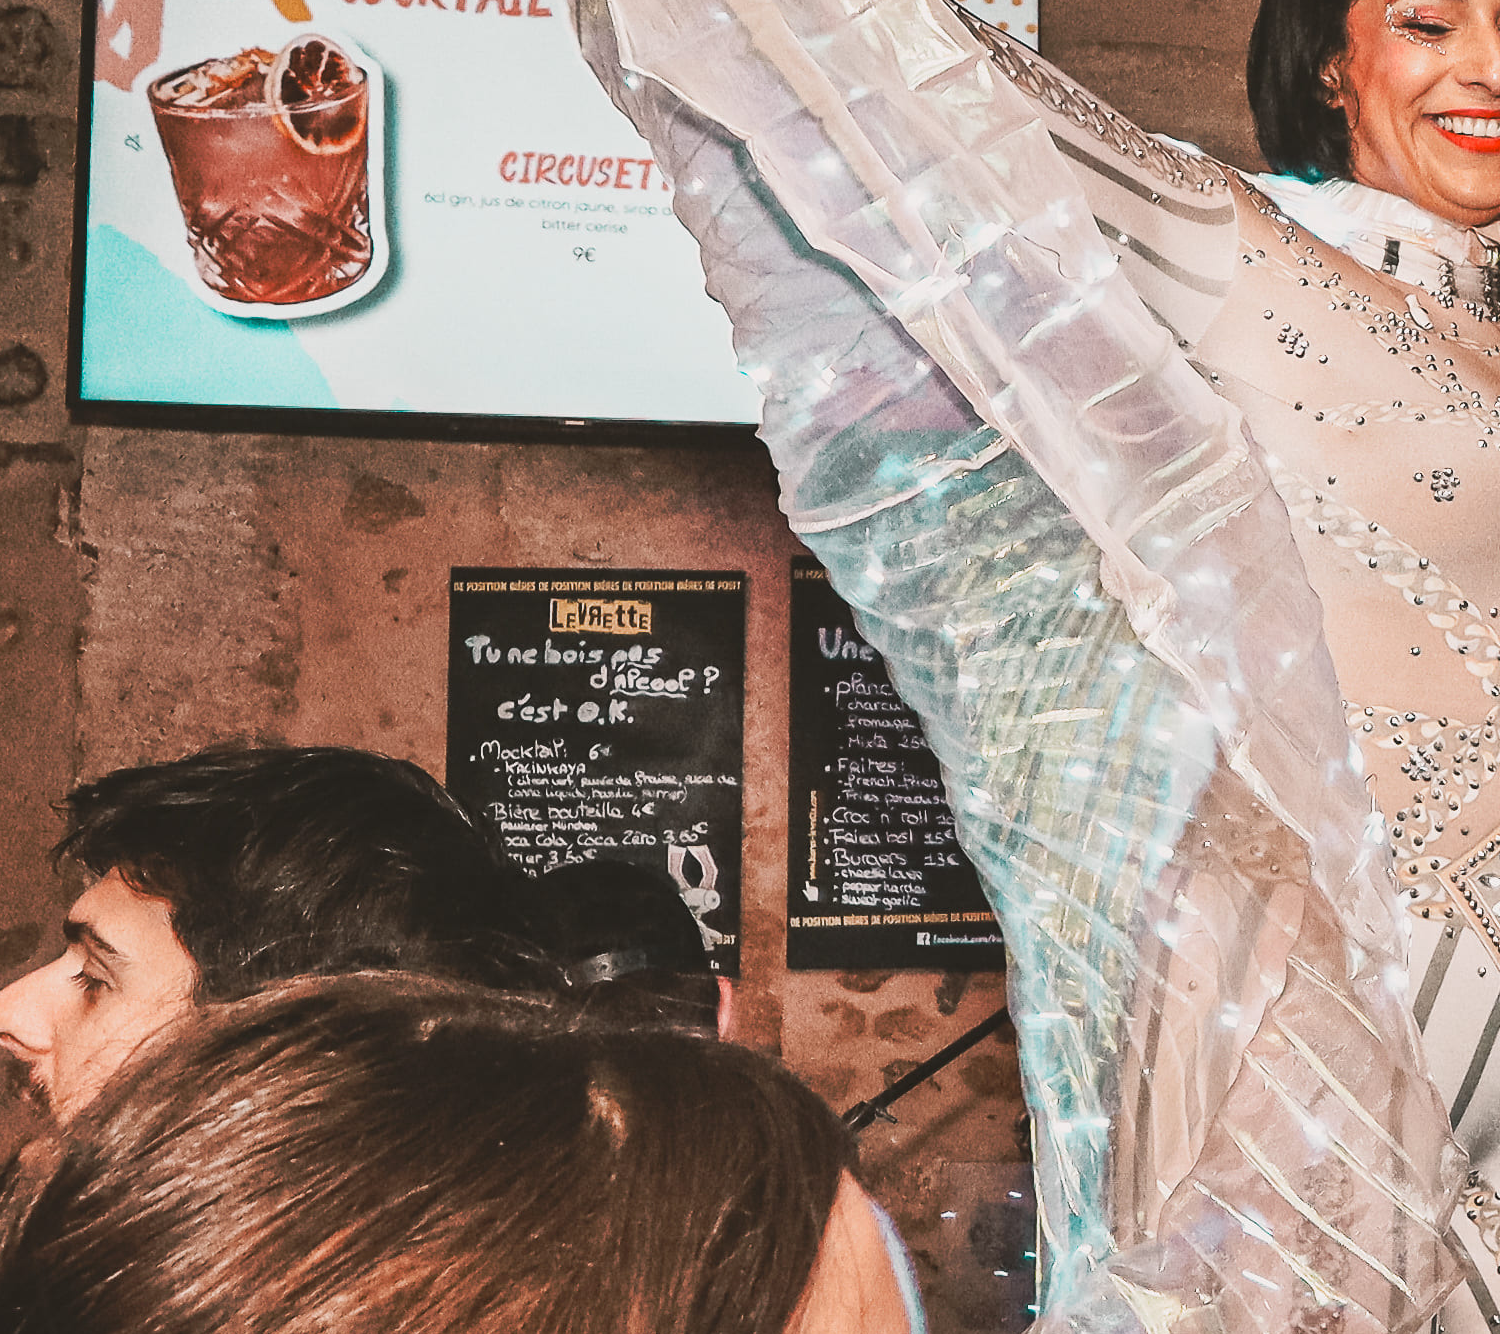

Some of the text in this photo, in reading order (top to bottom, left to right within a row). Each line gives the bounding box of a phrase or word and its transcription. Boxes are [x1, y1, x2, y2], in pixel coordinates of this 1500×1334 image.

[499, 151, 669, 191] CIRCUSET
[480, 196, 500, 208] jus
[504, 197, 524, 208] de
[528, 199, 570, 210] citron
[541, 219, 628, 234] bitter cerise
[572, 246, 596, 263] 9€
[454, 582, 463, 592] DE
[466, 581, 507, 592] POSITION
[538, 582, 548, 591] DE
[551, 581, 591, 591] POSITION
[622, 581, 632, 591] DE
[634, 580, 674, 591] POSITION
[705, 581, 715, 590] DE
[465, 635, 663, 670] Tu ne bois pas
[836, 672, 893, 707] planc
[497, 693, 634, 725] c'est O.K.
[847, 698, 903, 711] charcu
[488, 800, 655, 821] Bière bouteille 4€
[832, 806, 870, 823] Croc
[901, 809, 928, 824] roll
[577, 832, 619, 846] Coca
[832, 847, 960, 867] Burgers 13€
[790, 917, 800, 927] DE
[802, 915, 841, 927] POSITION
[882, 913, 921, 924] POSITION
